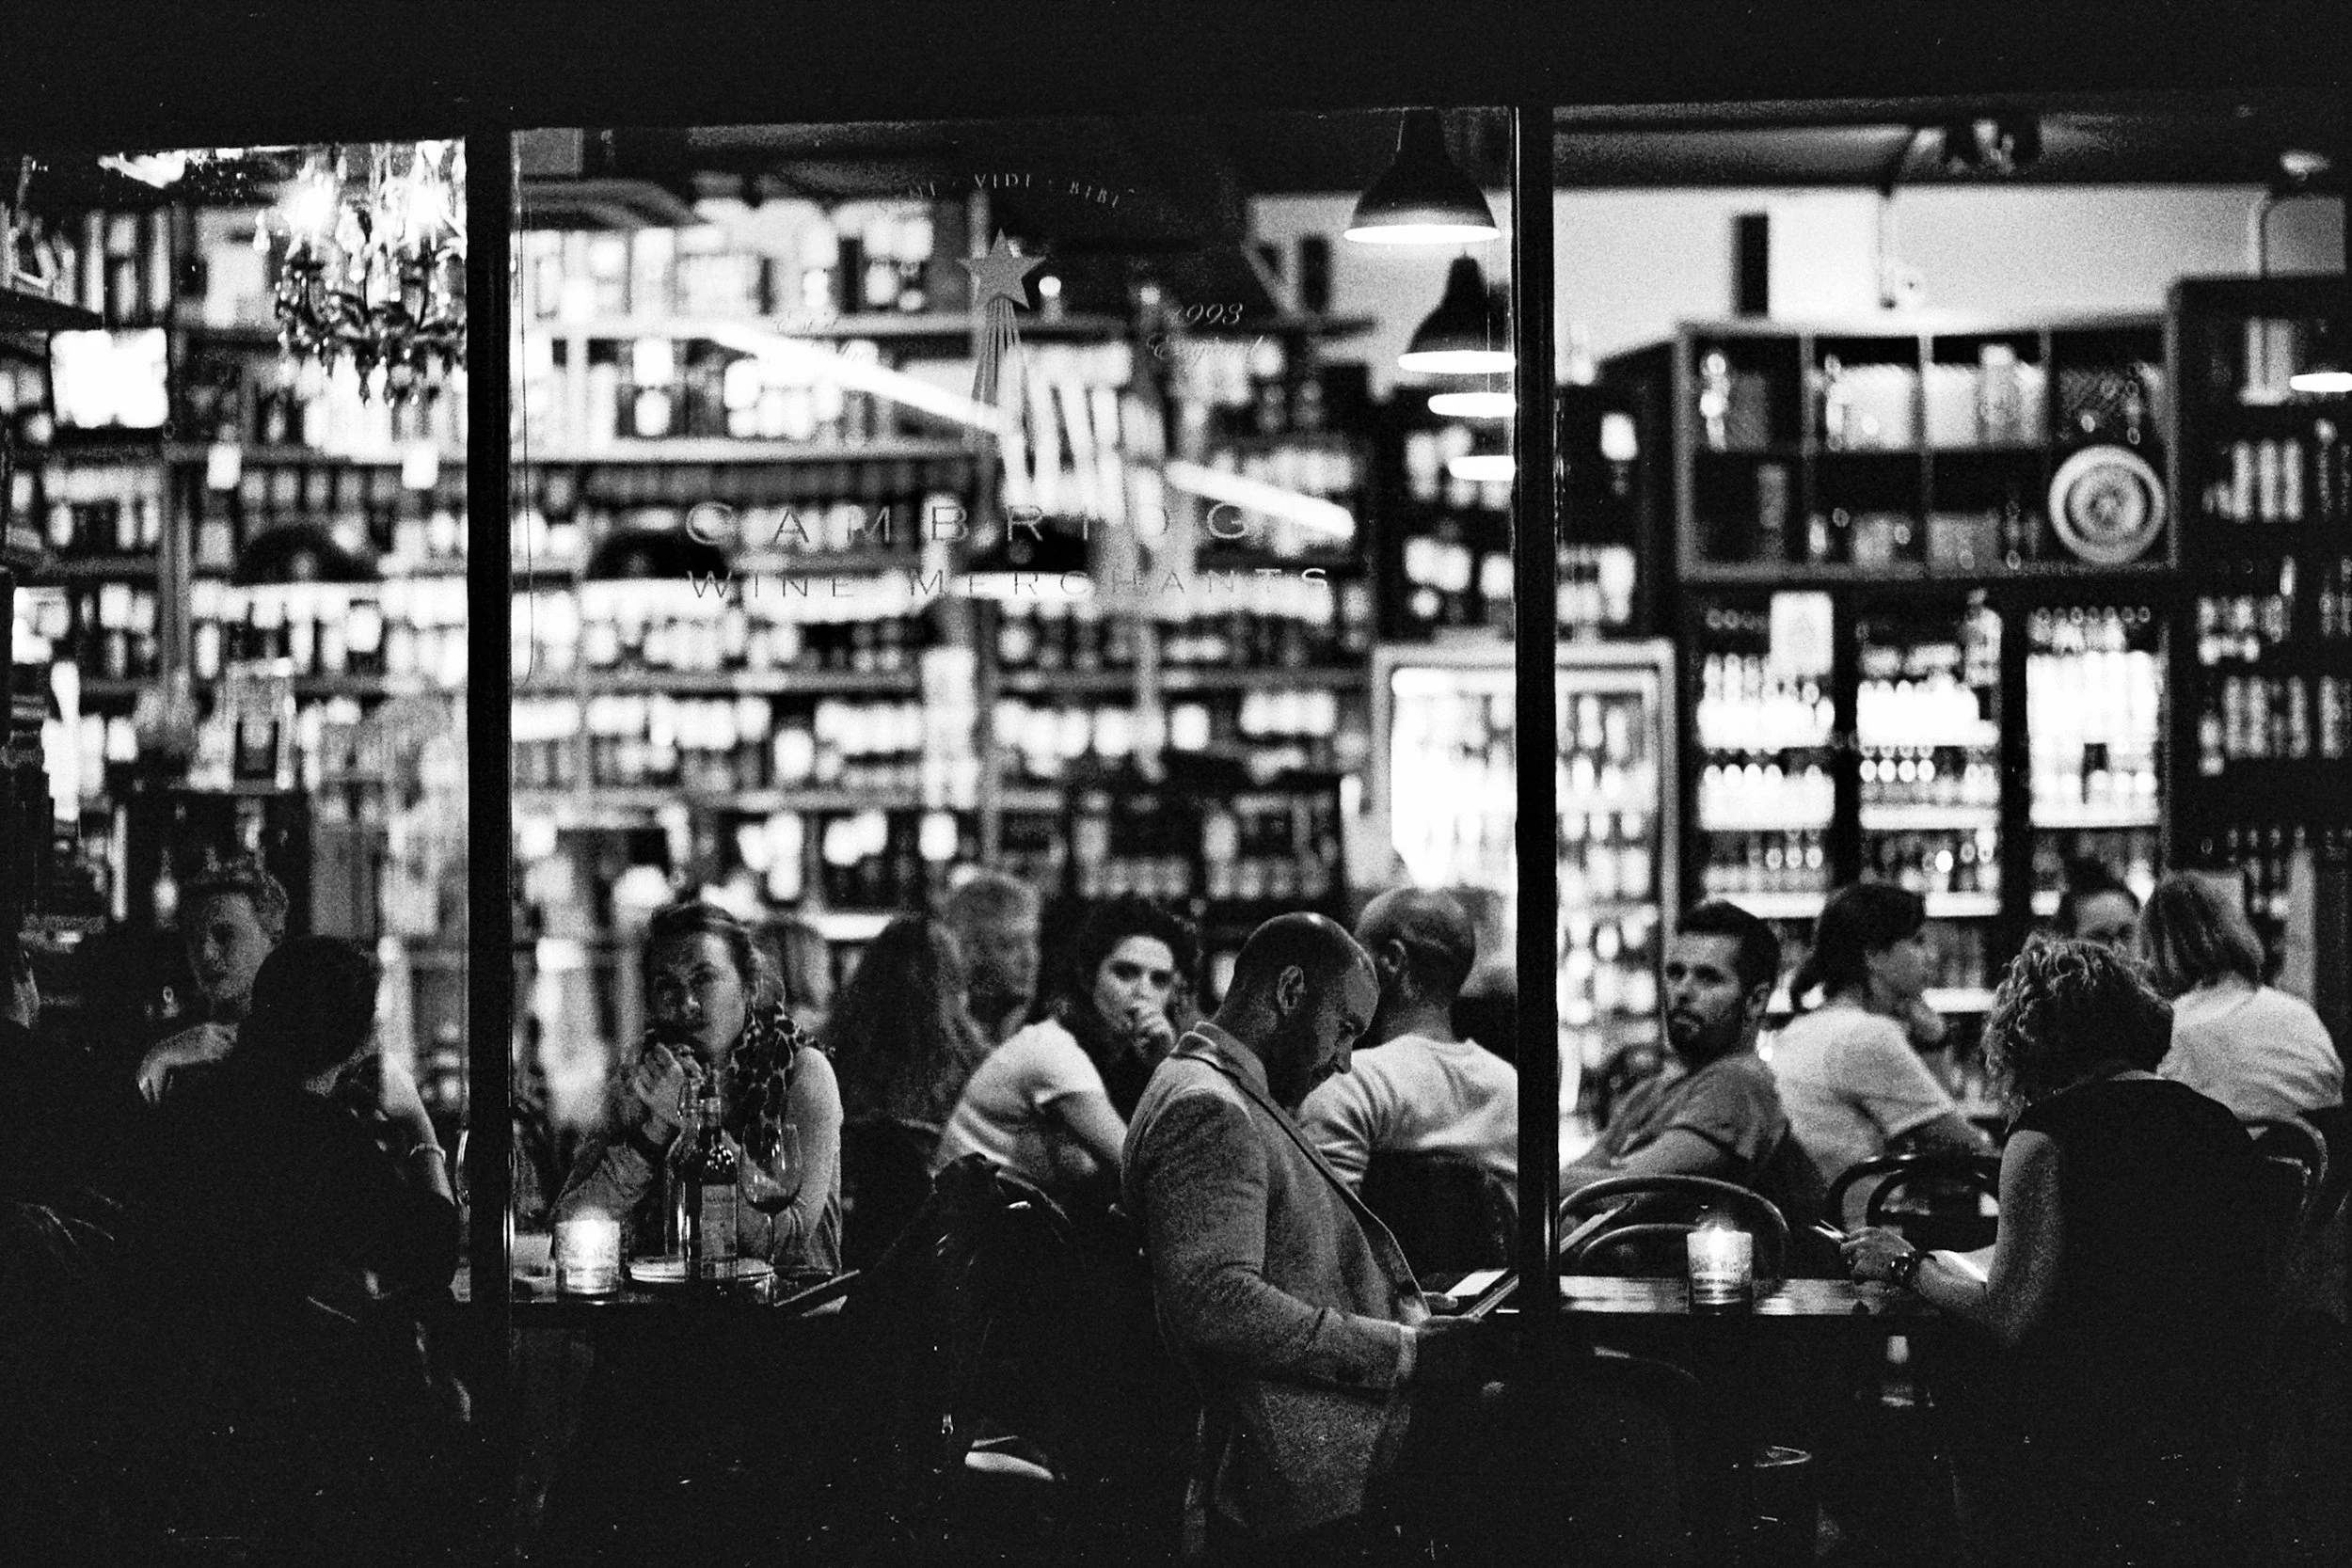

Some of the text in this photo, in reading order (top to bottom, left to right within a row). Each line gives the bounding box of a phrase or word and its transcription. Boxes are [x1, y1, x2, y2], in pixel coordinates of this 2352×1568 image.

[974, 172, 1031, 189] VIDI
[686, 500, 1249, 546] CAMBRIDG
[687, 567, 1328, 599] WINE MERCHANTS
